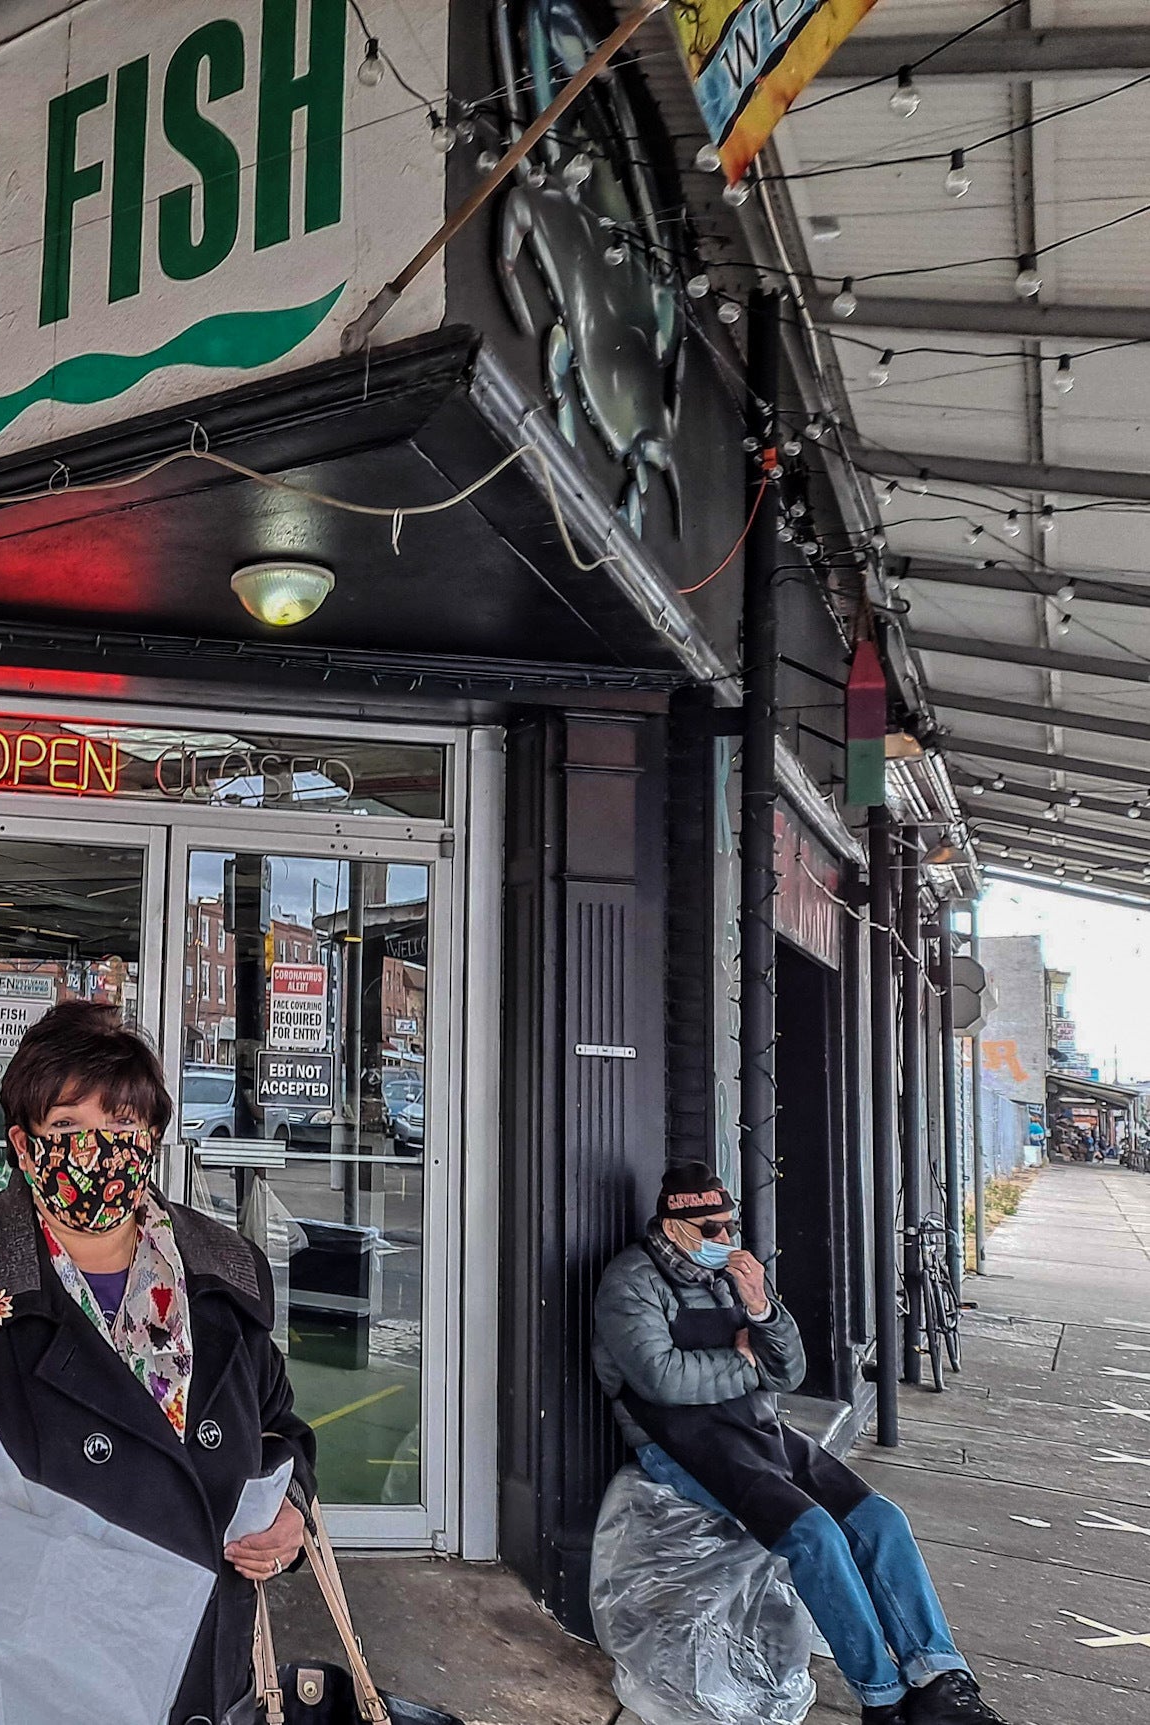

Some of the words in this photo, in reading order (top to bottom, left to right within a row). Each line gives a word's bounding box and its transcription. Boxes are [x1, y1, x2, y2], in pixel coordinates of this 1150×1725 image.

[38, 0, 348, 328] FISH
[156, 745, 356, 808] CLOSED
[274, 969, 322, 982] CORONAVIRUS
[287, 981, 309, 993] ALERT
[272, 999, 290, 1010] FACE
[291, 1000, 322, 1012] COVERING
[0, 1007, 27, 1021] FISH
[272, 1011, 322, 1027] REQUIRED
[272, 1026, 290, 1040] FOR
[293, 1027, 322, 1042] ENTRY
[269, 1063, 294, 1078] EBT
[296, 1063, 323, 1080] NOT
[260, 1079, 329, 1098] ACCEPTED
